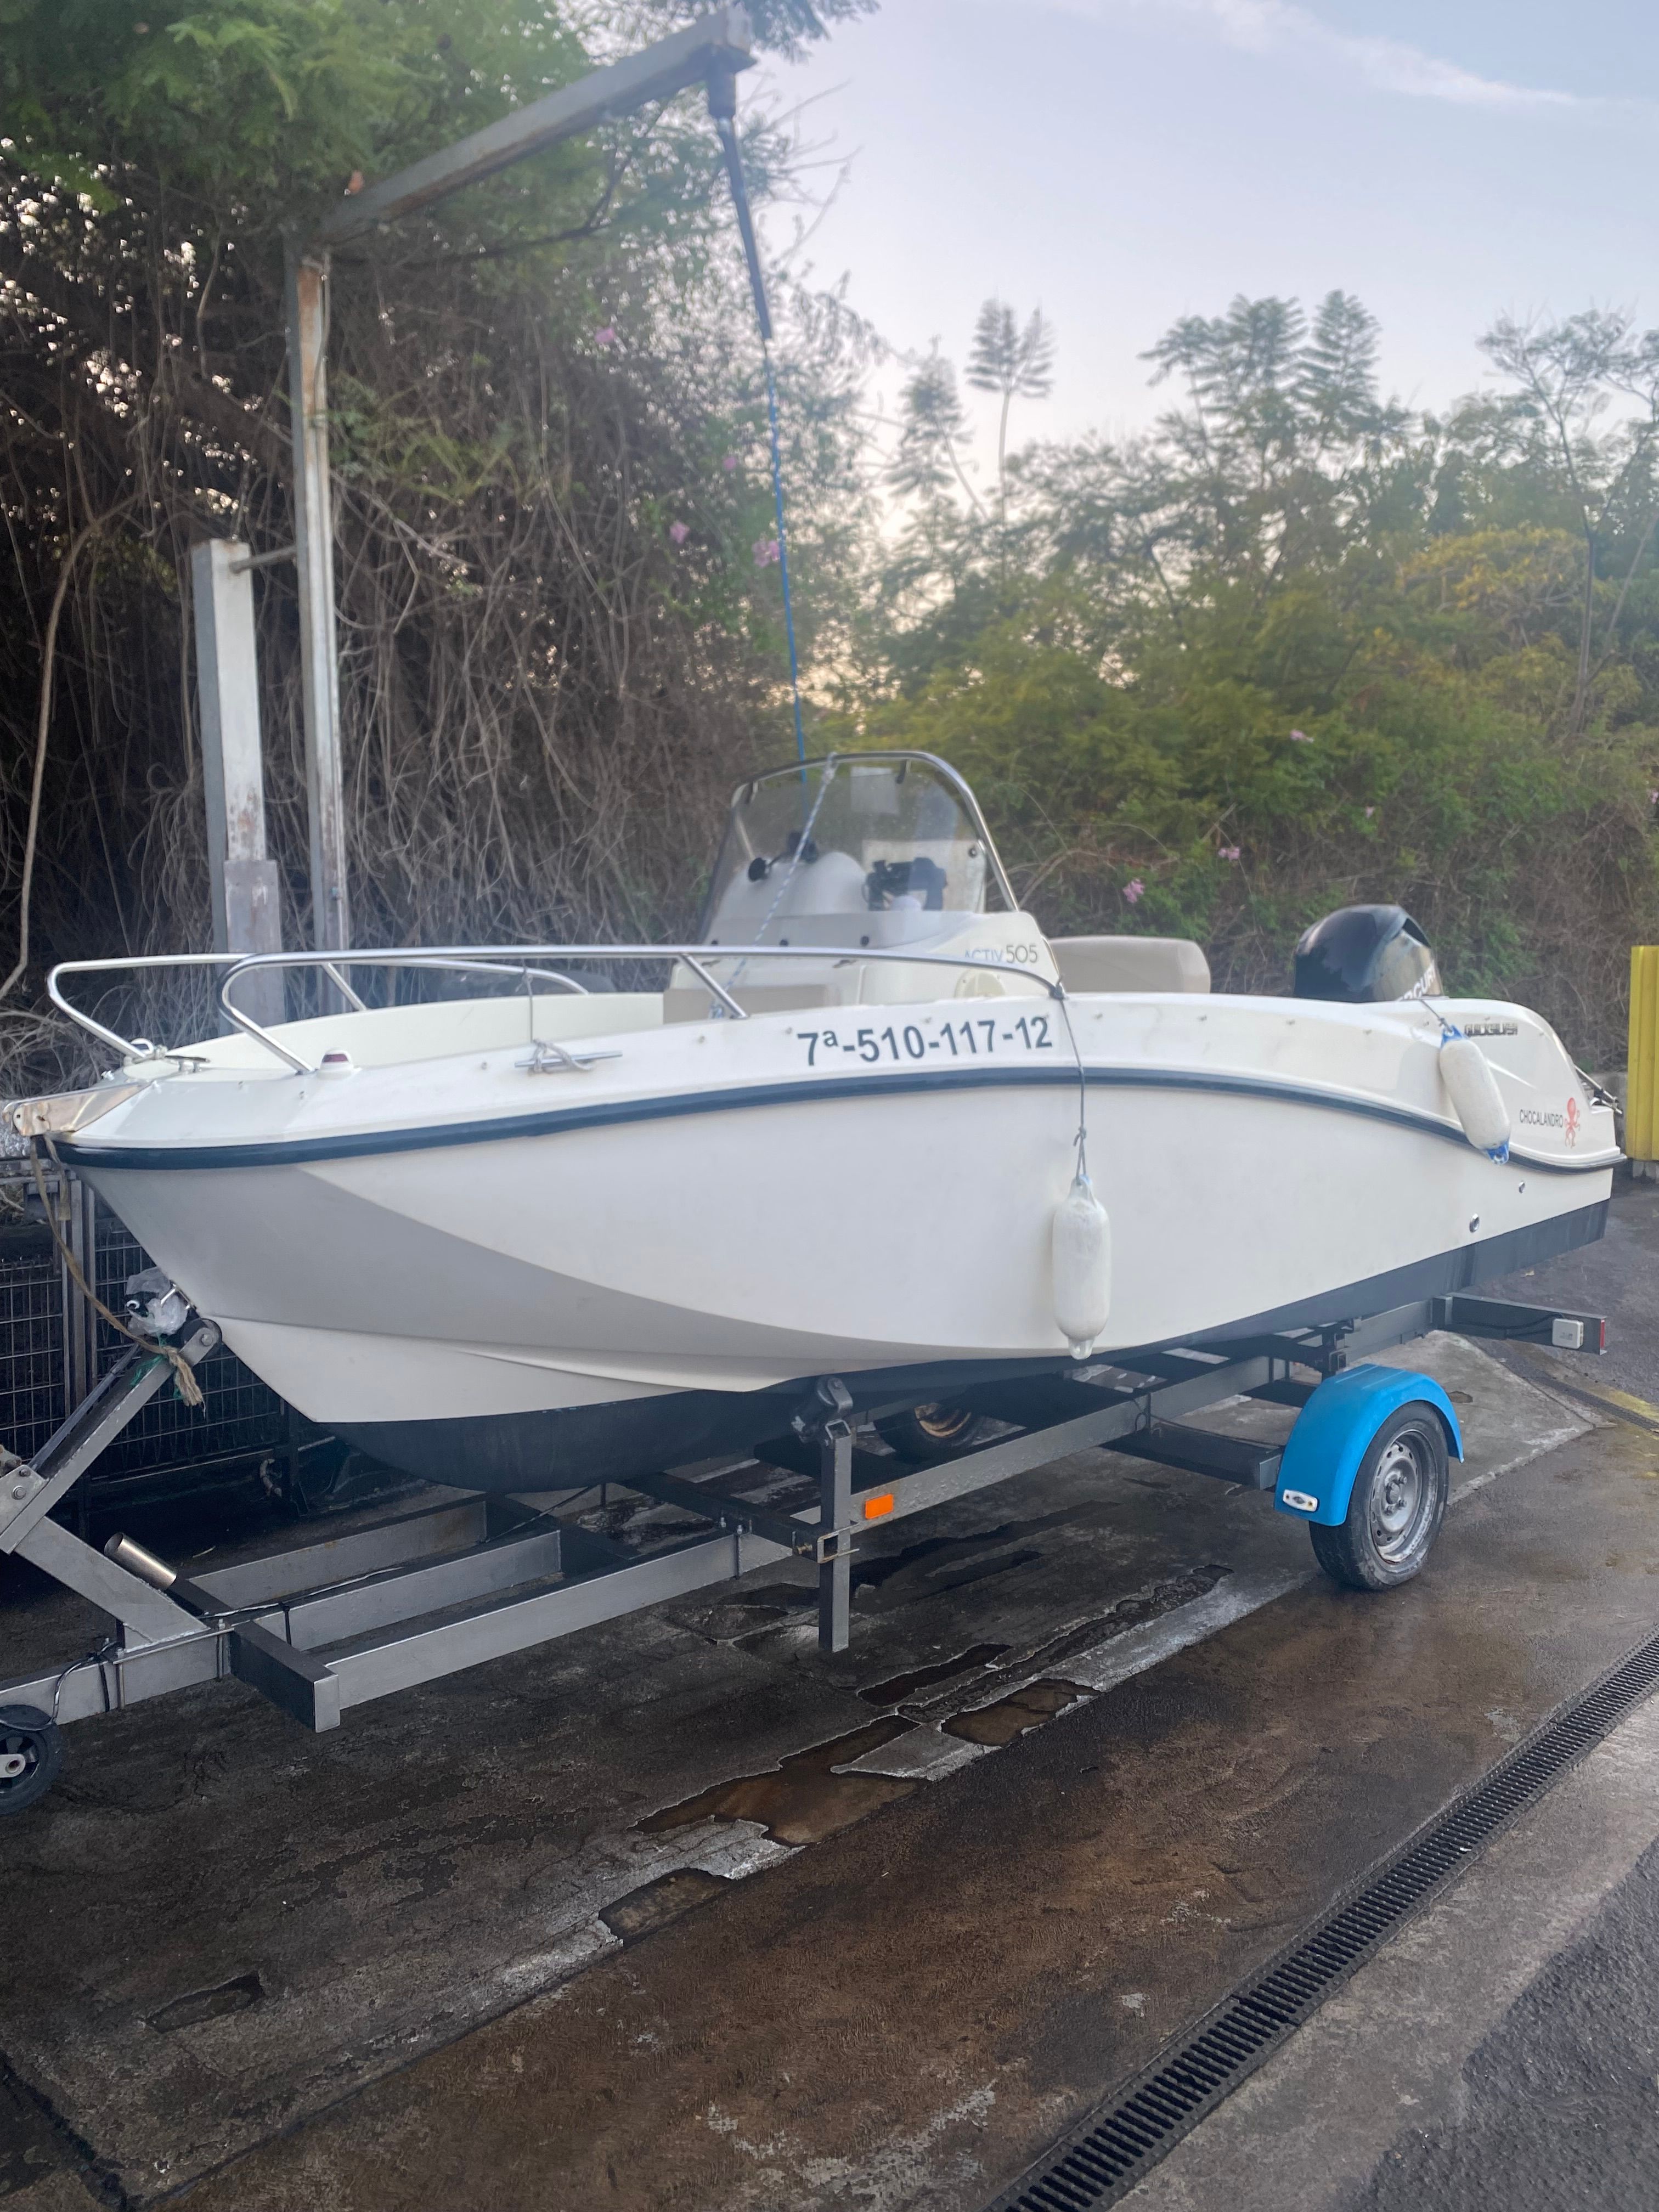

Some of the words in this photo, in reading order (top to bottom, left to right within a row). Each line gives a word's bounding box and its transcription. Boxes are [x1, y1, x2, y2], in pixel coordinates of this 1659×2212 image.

[1006, 944, 1039, 963] 505
[797, 1016, 1053, 1066] 7ª-510-117-12
[1519, 1109, 1564, 1128] CHOCALANDRO
